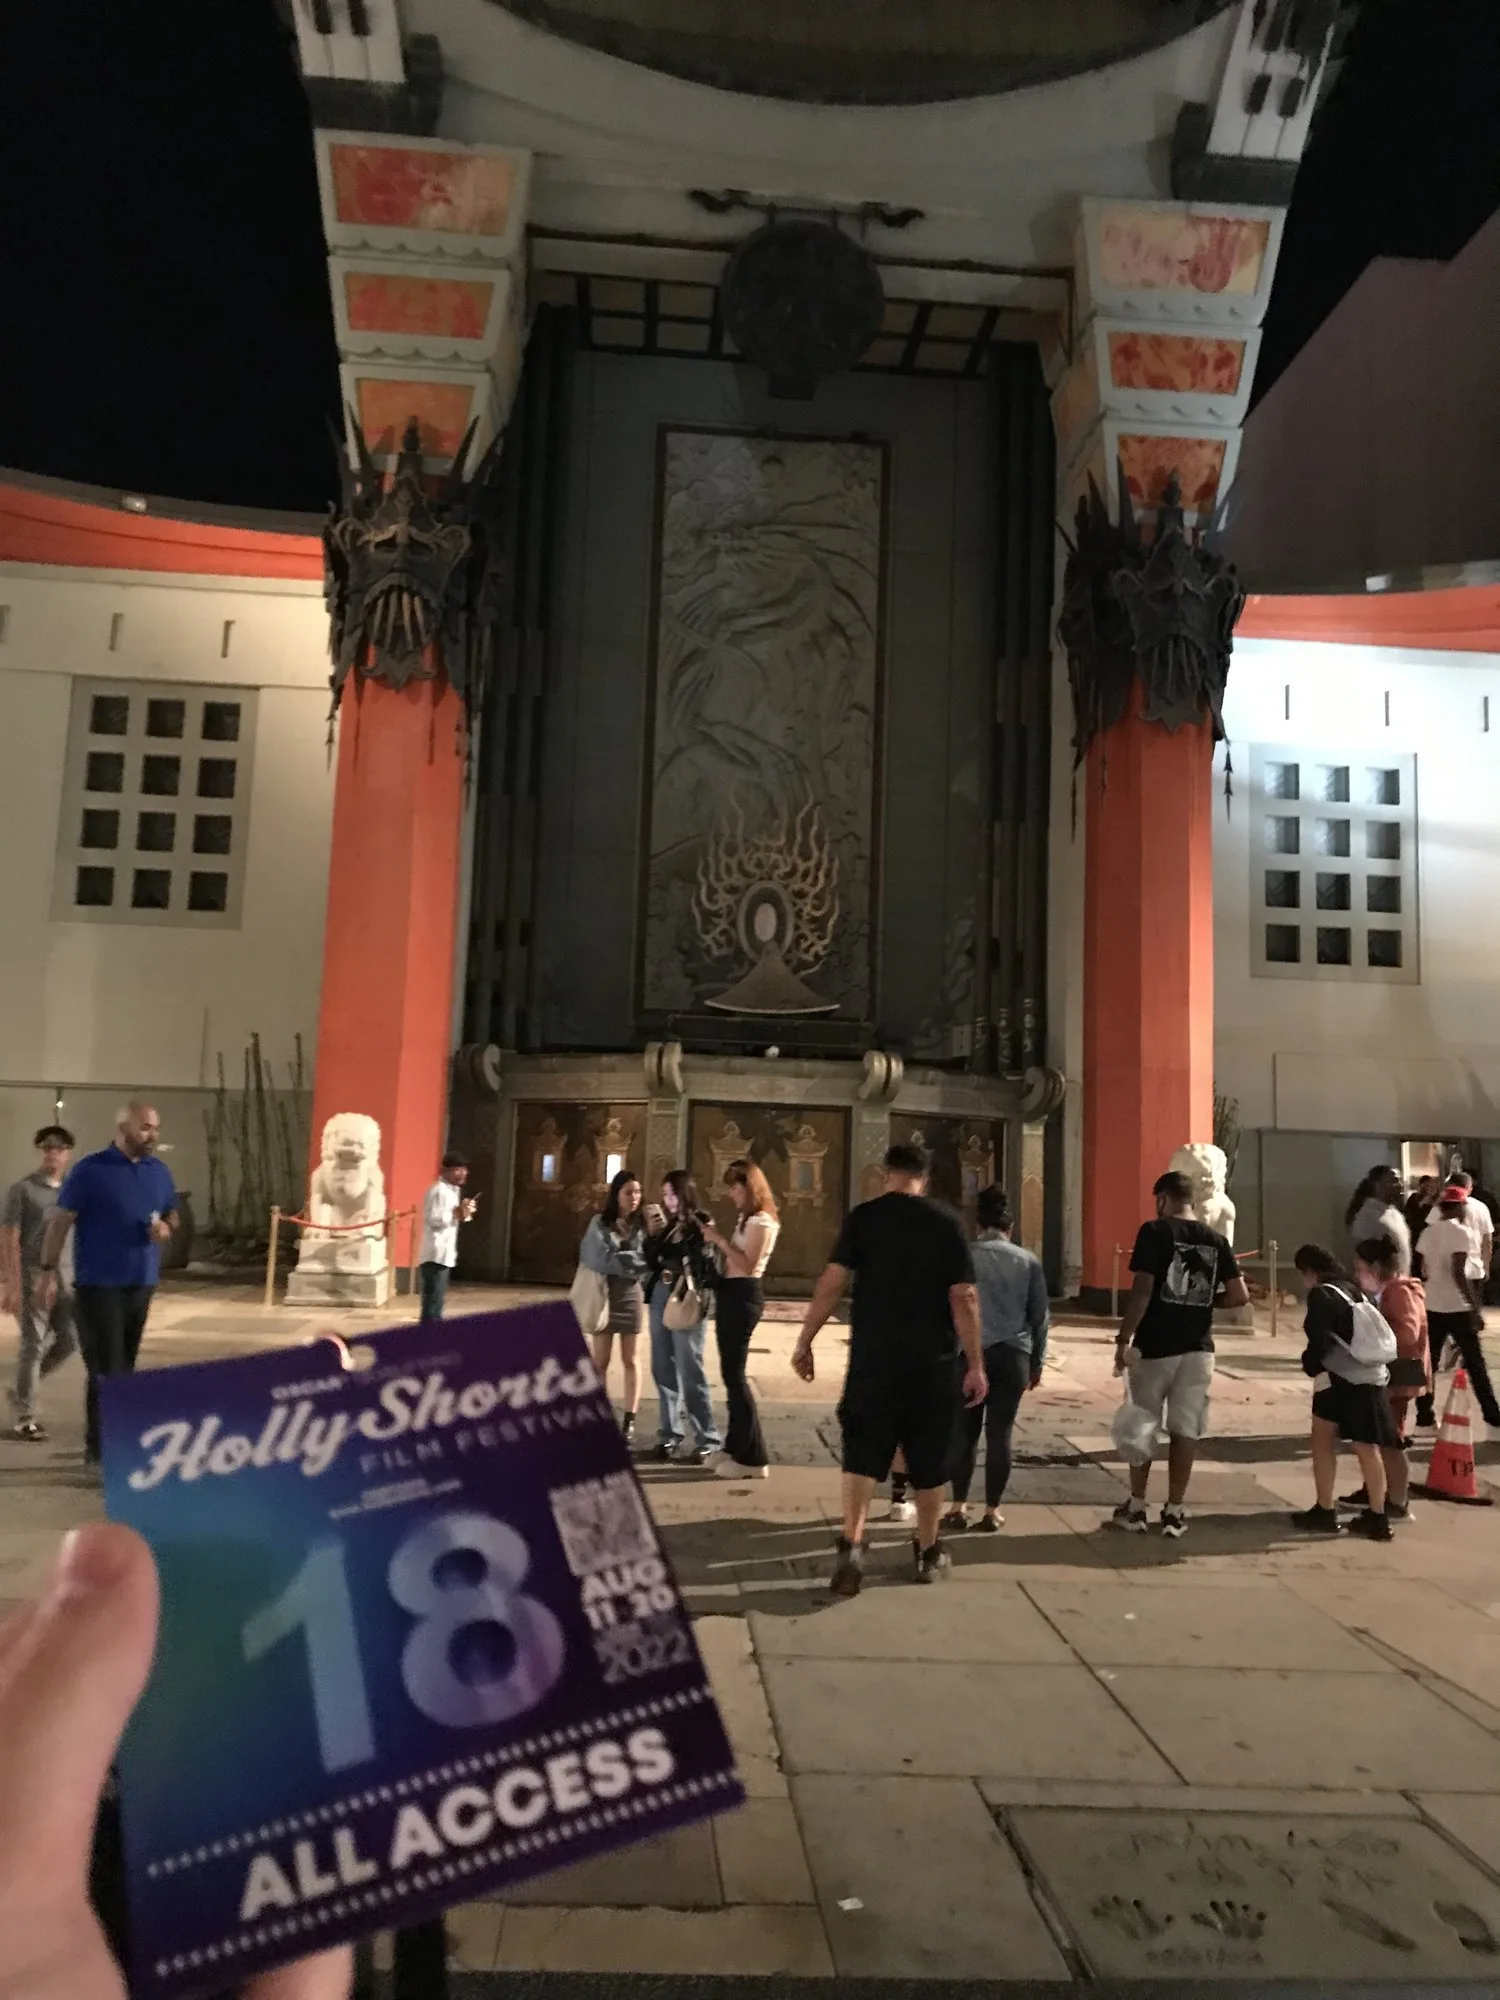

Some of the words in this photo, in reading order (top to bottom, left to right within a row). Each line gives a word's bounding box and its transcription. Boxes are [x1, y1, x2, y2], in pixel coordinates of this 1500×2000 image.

[358, 1438, 442, 1475] FILM
[240, 1509, 566, 1775] 18
[239, 1827, 377, 1921] ALL
[389, 1727, 675, 1868] ACCESS
